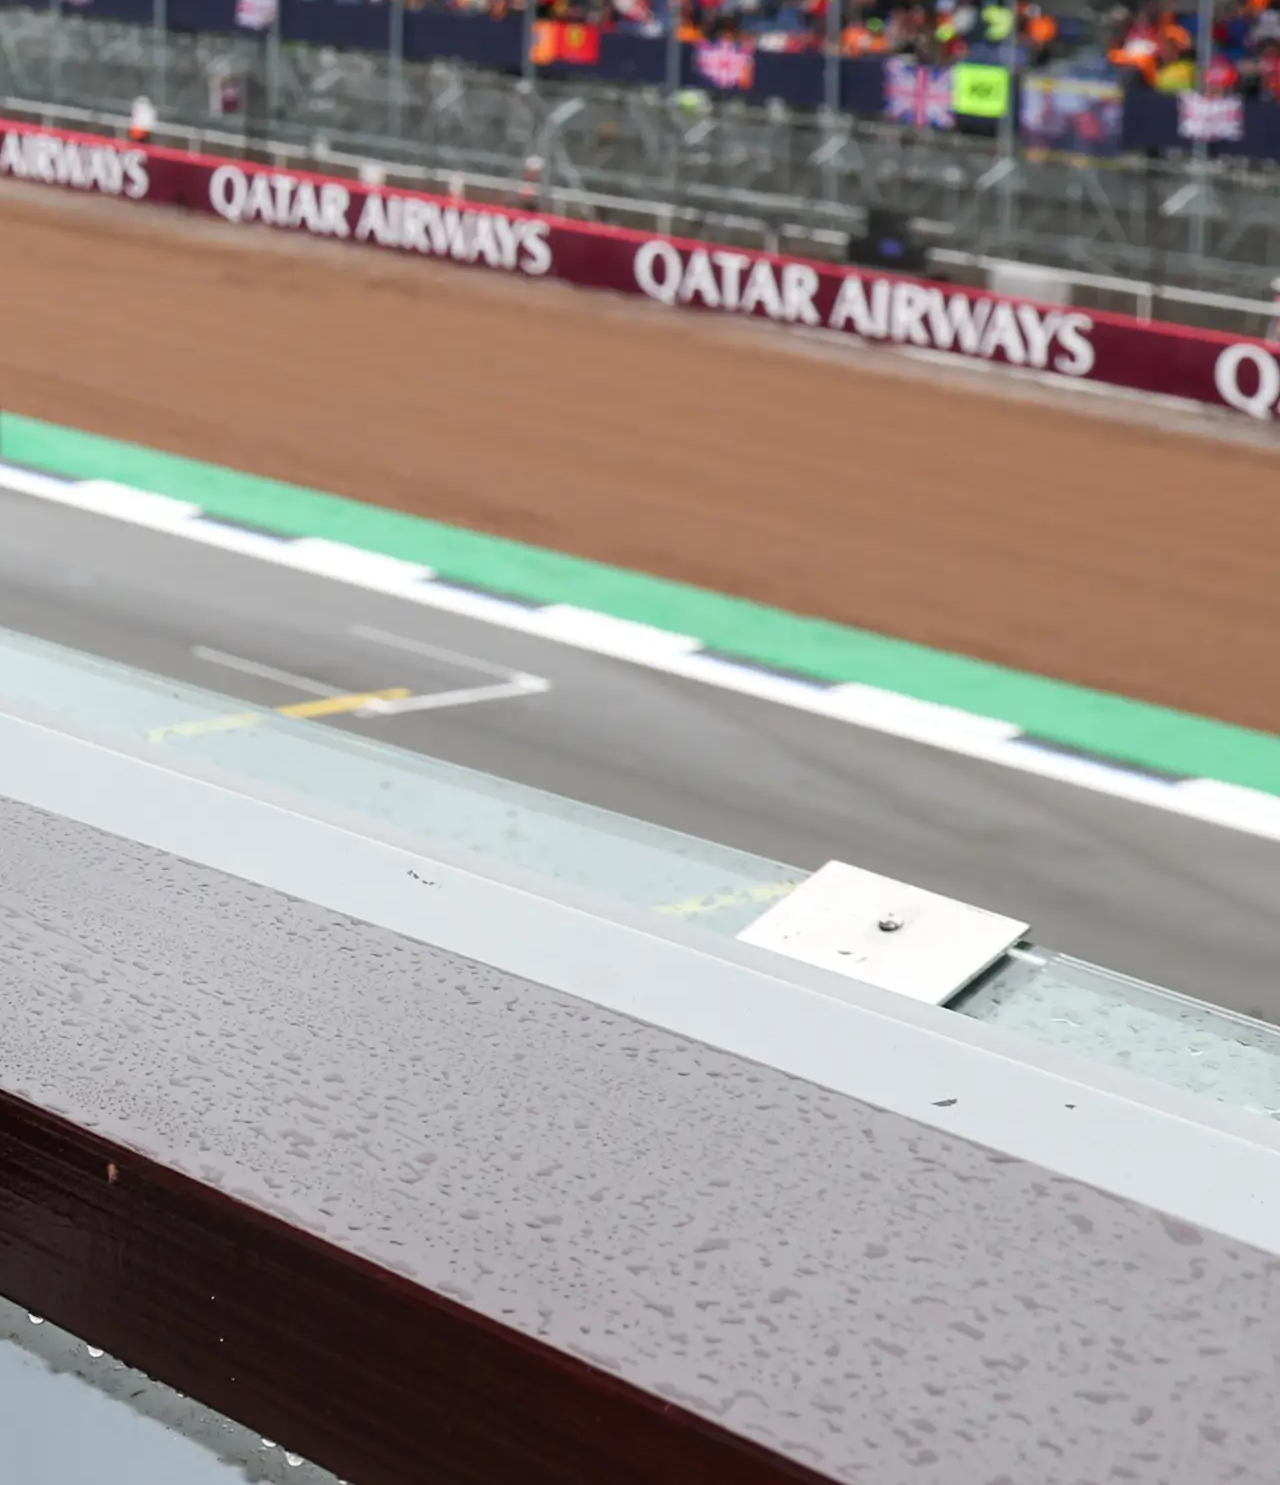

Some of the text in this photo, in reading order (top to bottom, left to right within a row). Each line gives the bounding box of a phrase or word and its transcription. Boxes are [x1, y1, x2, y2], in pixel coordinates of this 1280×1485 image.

[209, 164, 553, 275] QATAR AIRWAYS
[633, 240, 1096, 377] QATAR AIRWAYS
